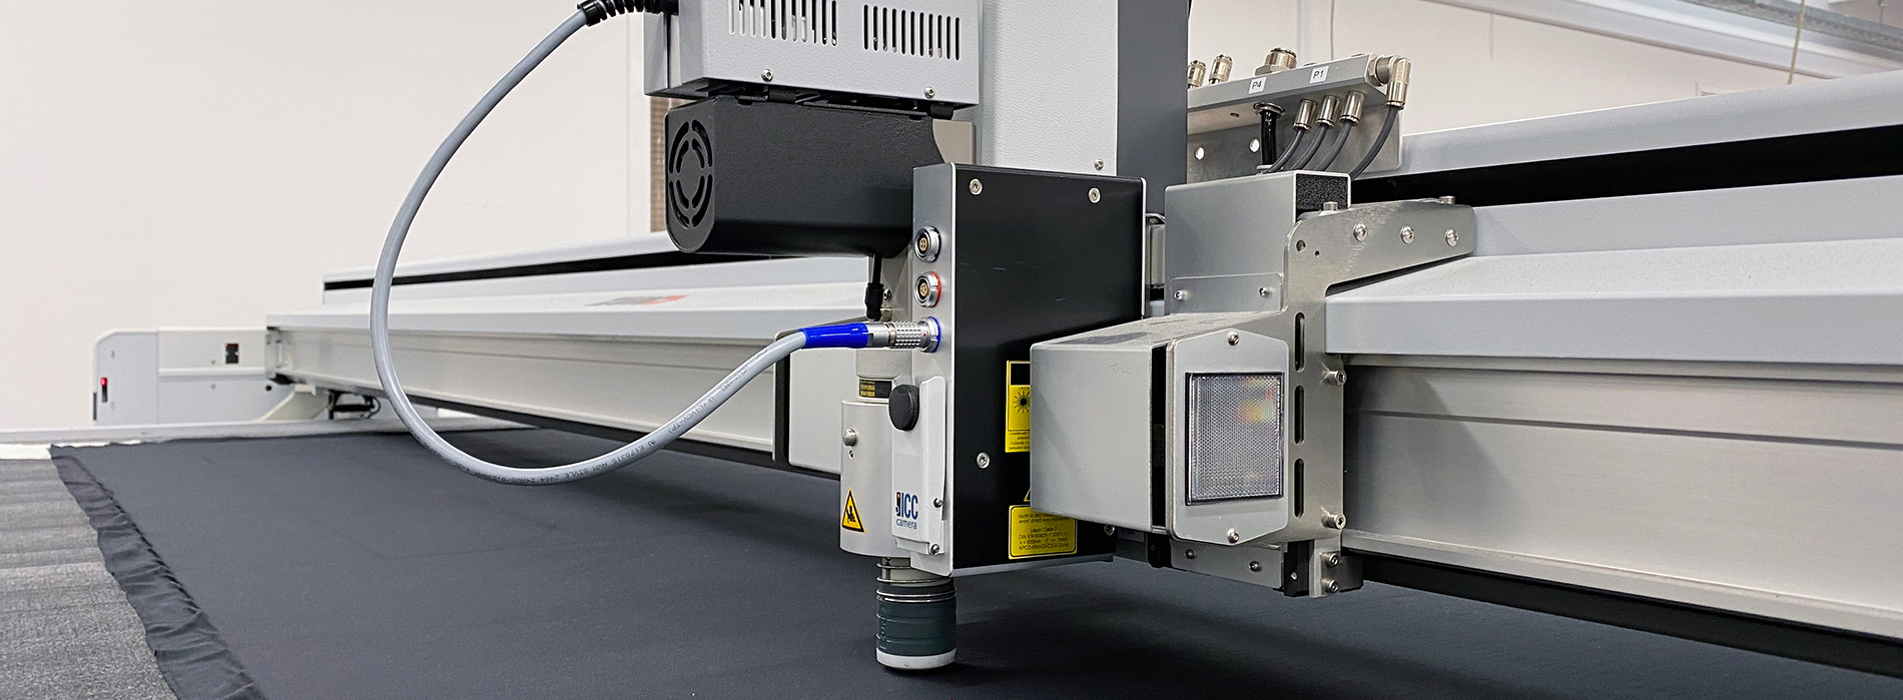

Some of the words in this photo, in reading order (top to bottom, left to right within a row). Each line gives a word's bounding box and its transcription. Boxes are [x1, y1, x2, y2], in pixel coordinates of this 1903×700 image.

[1312, 70, 1324, 80] P1
[1251, 80, 1262, 90] P4
[611, 444, 645, 466] E170315
[540, 474, 560, 482] 2464
[563, 467, 589, 478] STYLE
[901, 492, 919, 520] ICC
[895, 518, 917, 530] camera
